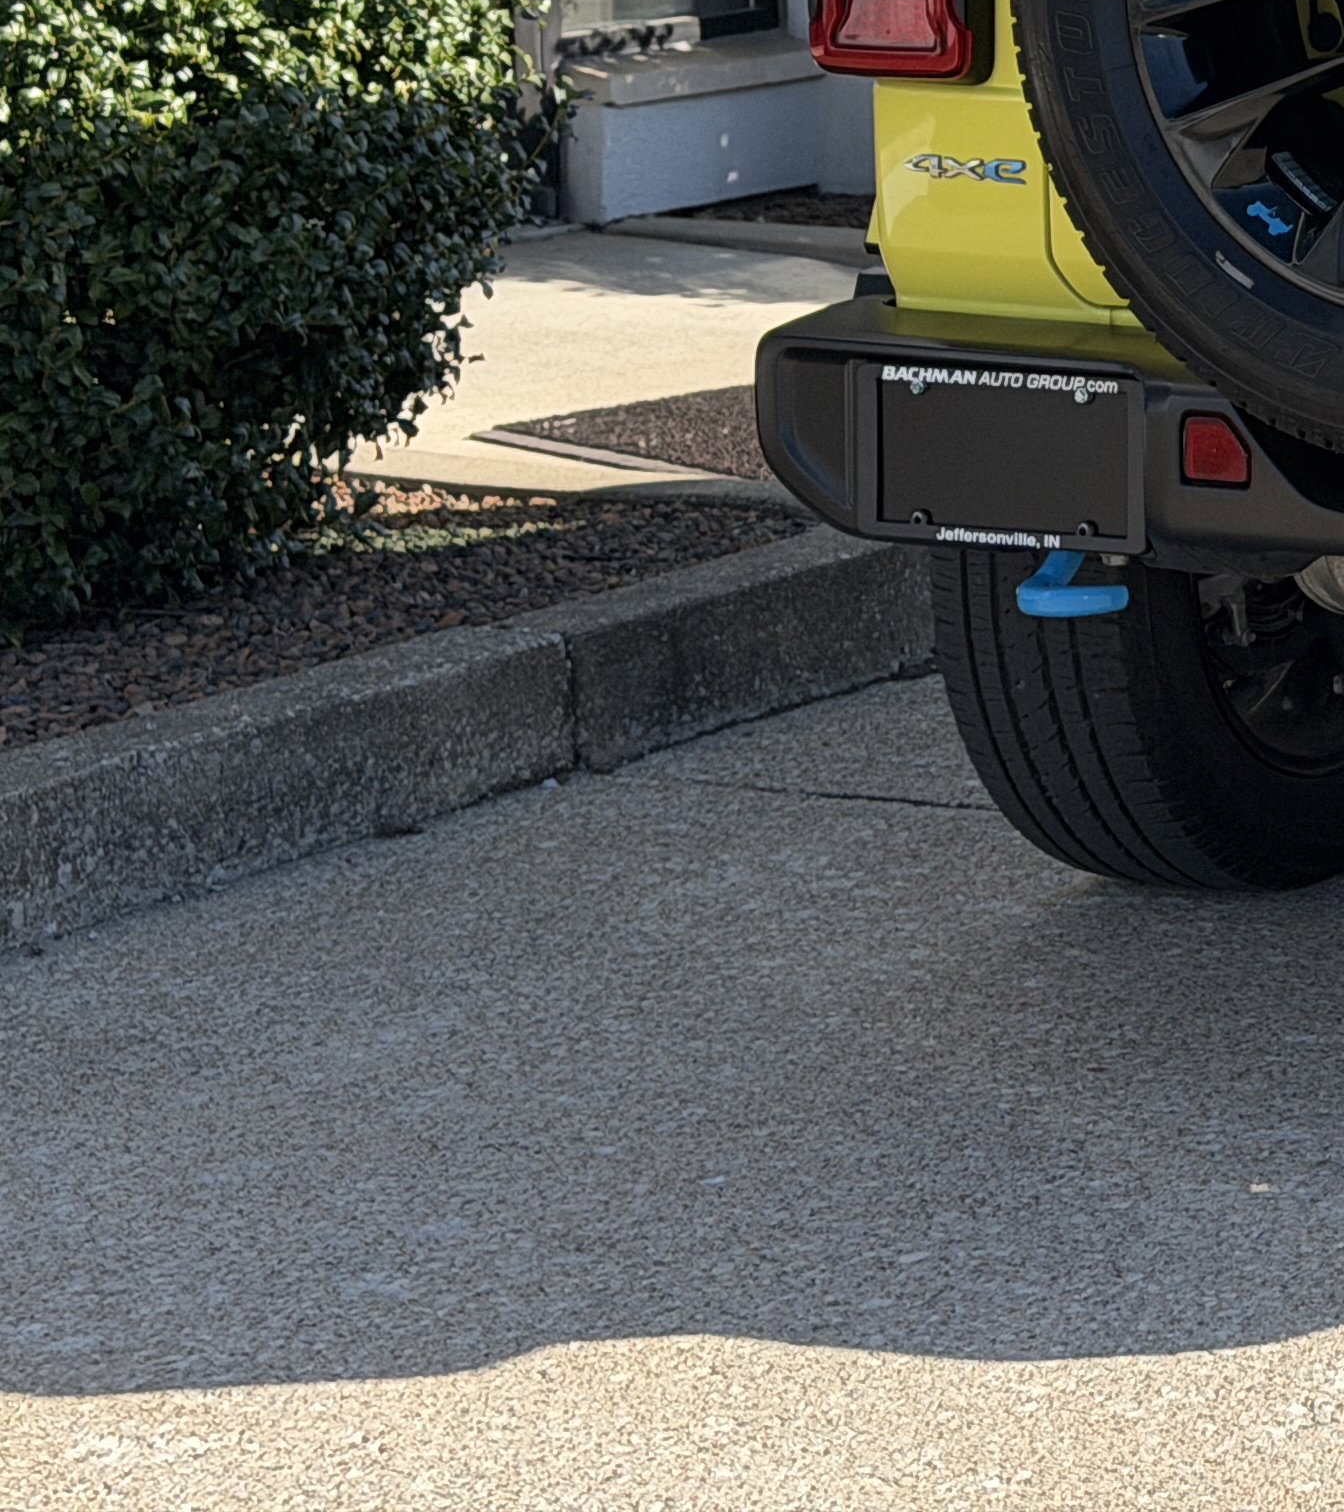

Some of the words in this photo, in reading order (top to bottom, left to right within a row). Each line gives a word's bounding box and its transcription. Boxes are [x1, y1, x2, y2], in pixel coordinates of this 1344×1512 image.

[882, 365, 977, 385] BACHMAN
[978, 372, 1023, 388] AUTO
[936, 527, 1040, 549] Jeffersonville,
[1044, 534, 1061, 549] IN
